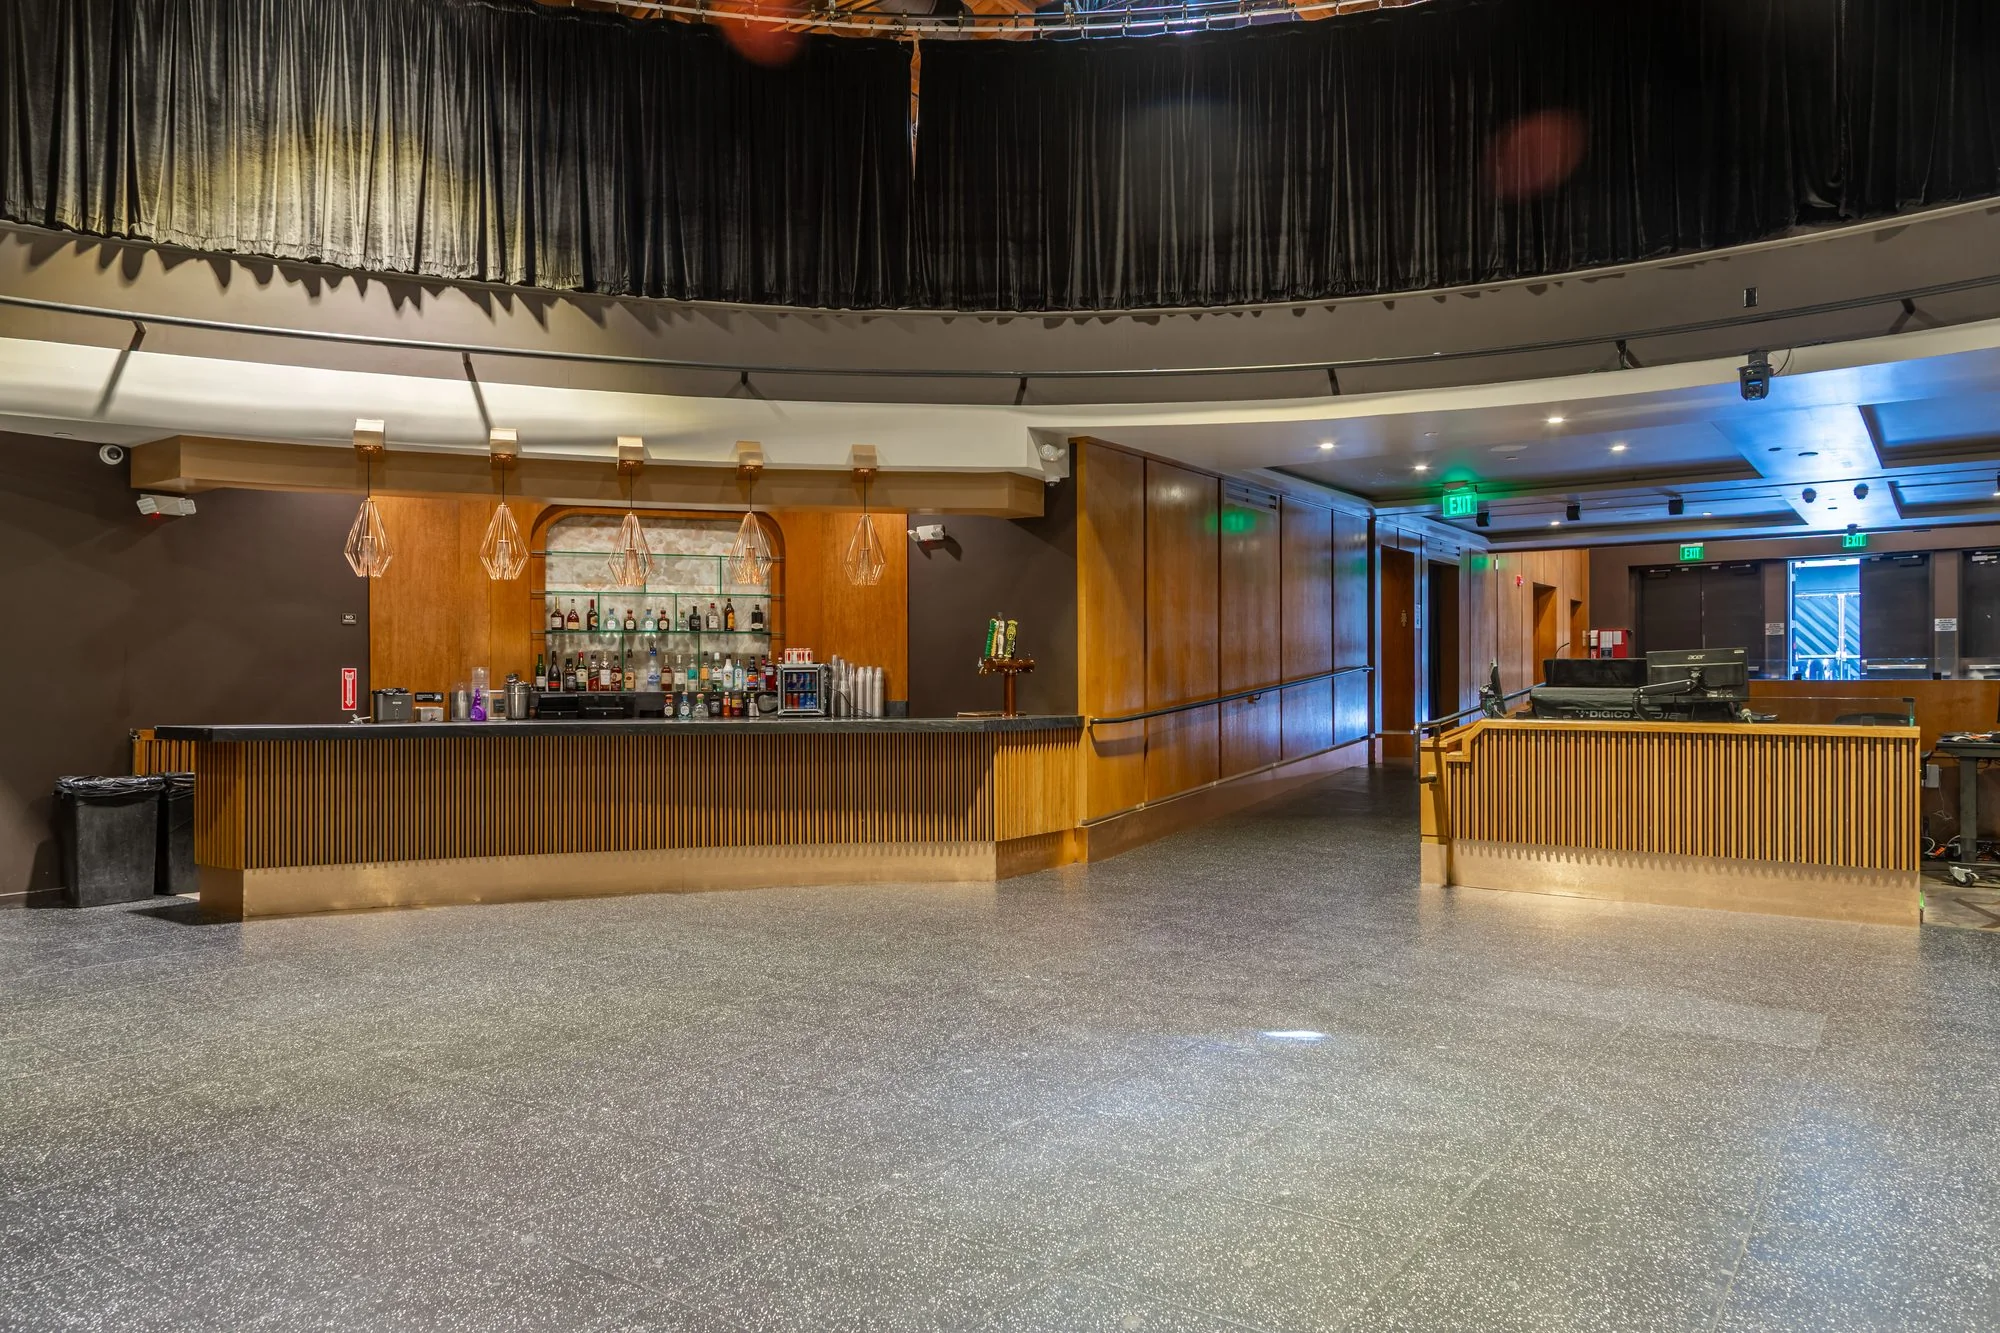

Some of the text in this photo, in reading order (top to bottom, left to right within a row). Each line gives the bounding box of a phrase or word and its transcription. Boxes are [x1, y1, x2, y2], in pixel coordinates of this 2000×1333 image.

[1449, 495, 1473, 515] EXIT
[1846, 535, 1865, 546] EXIT
[1684, 547, 1701, 559] EXIT
